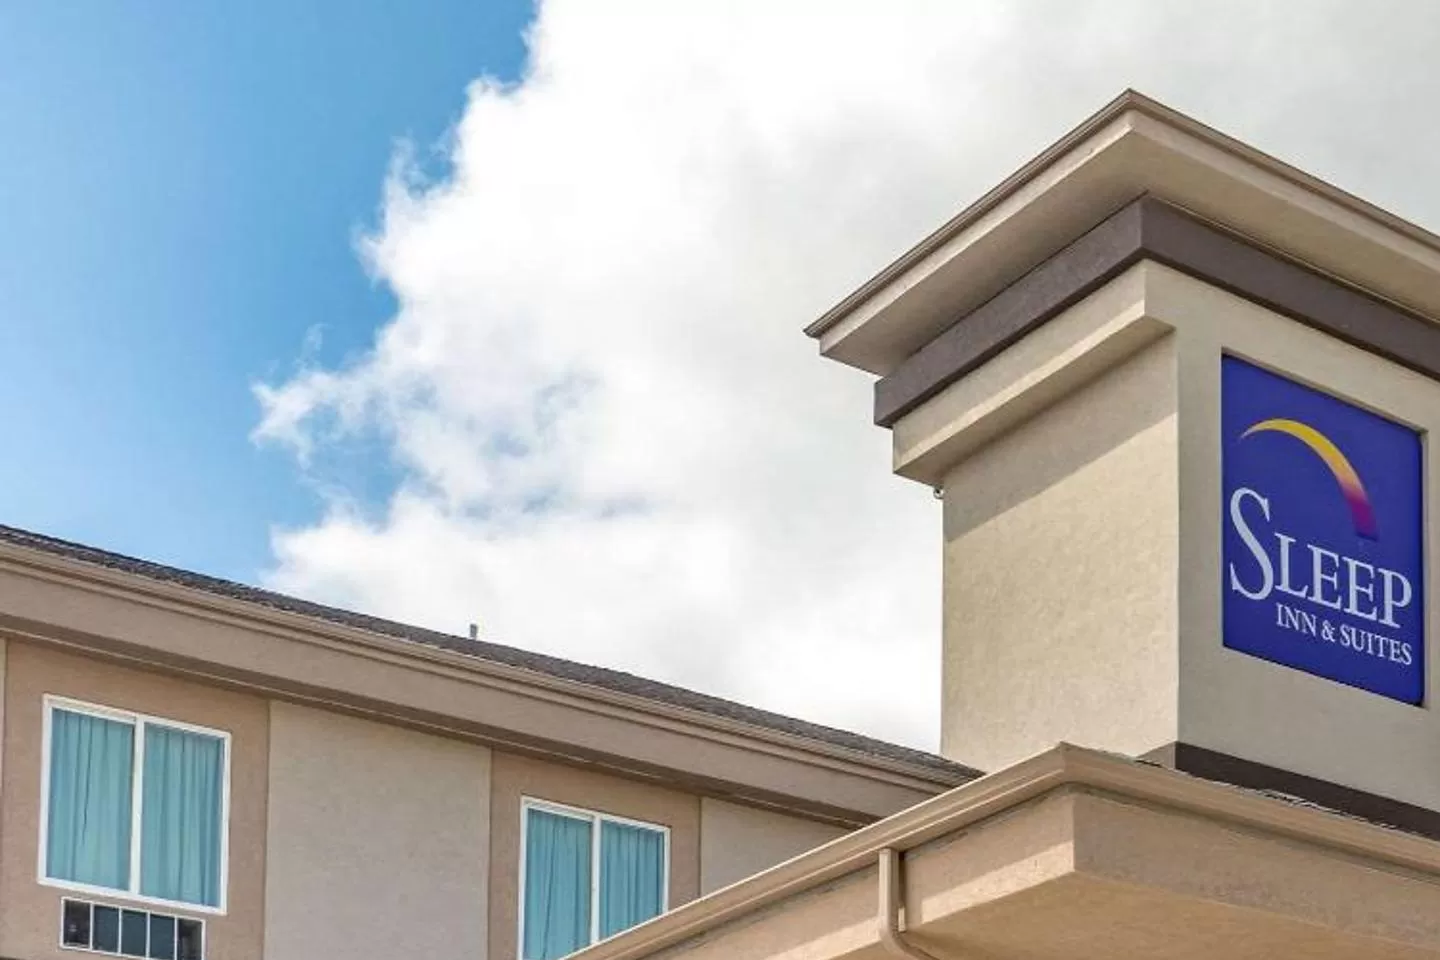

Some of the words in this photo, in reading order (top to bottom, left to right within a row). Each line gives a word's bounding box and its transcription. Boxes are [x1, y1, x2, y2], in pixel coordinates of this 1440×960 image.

[1230, 487, 1412, 629] SLEEP
[1276, 602, 1316, 636] INN
[1322, 620, 1336, 643] &
[1340, 623, 1413, 667] SUITES
